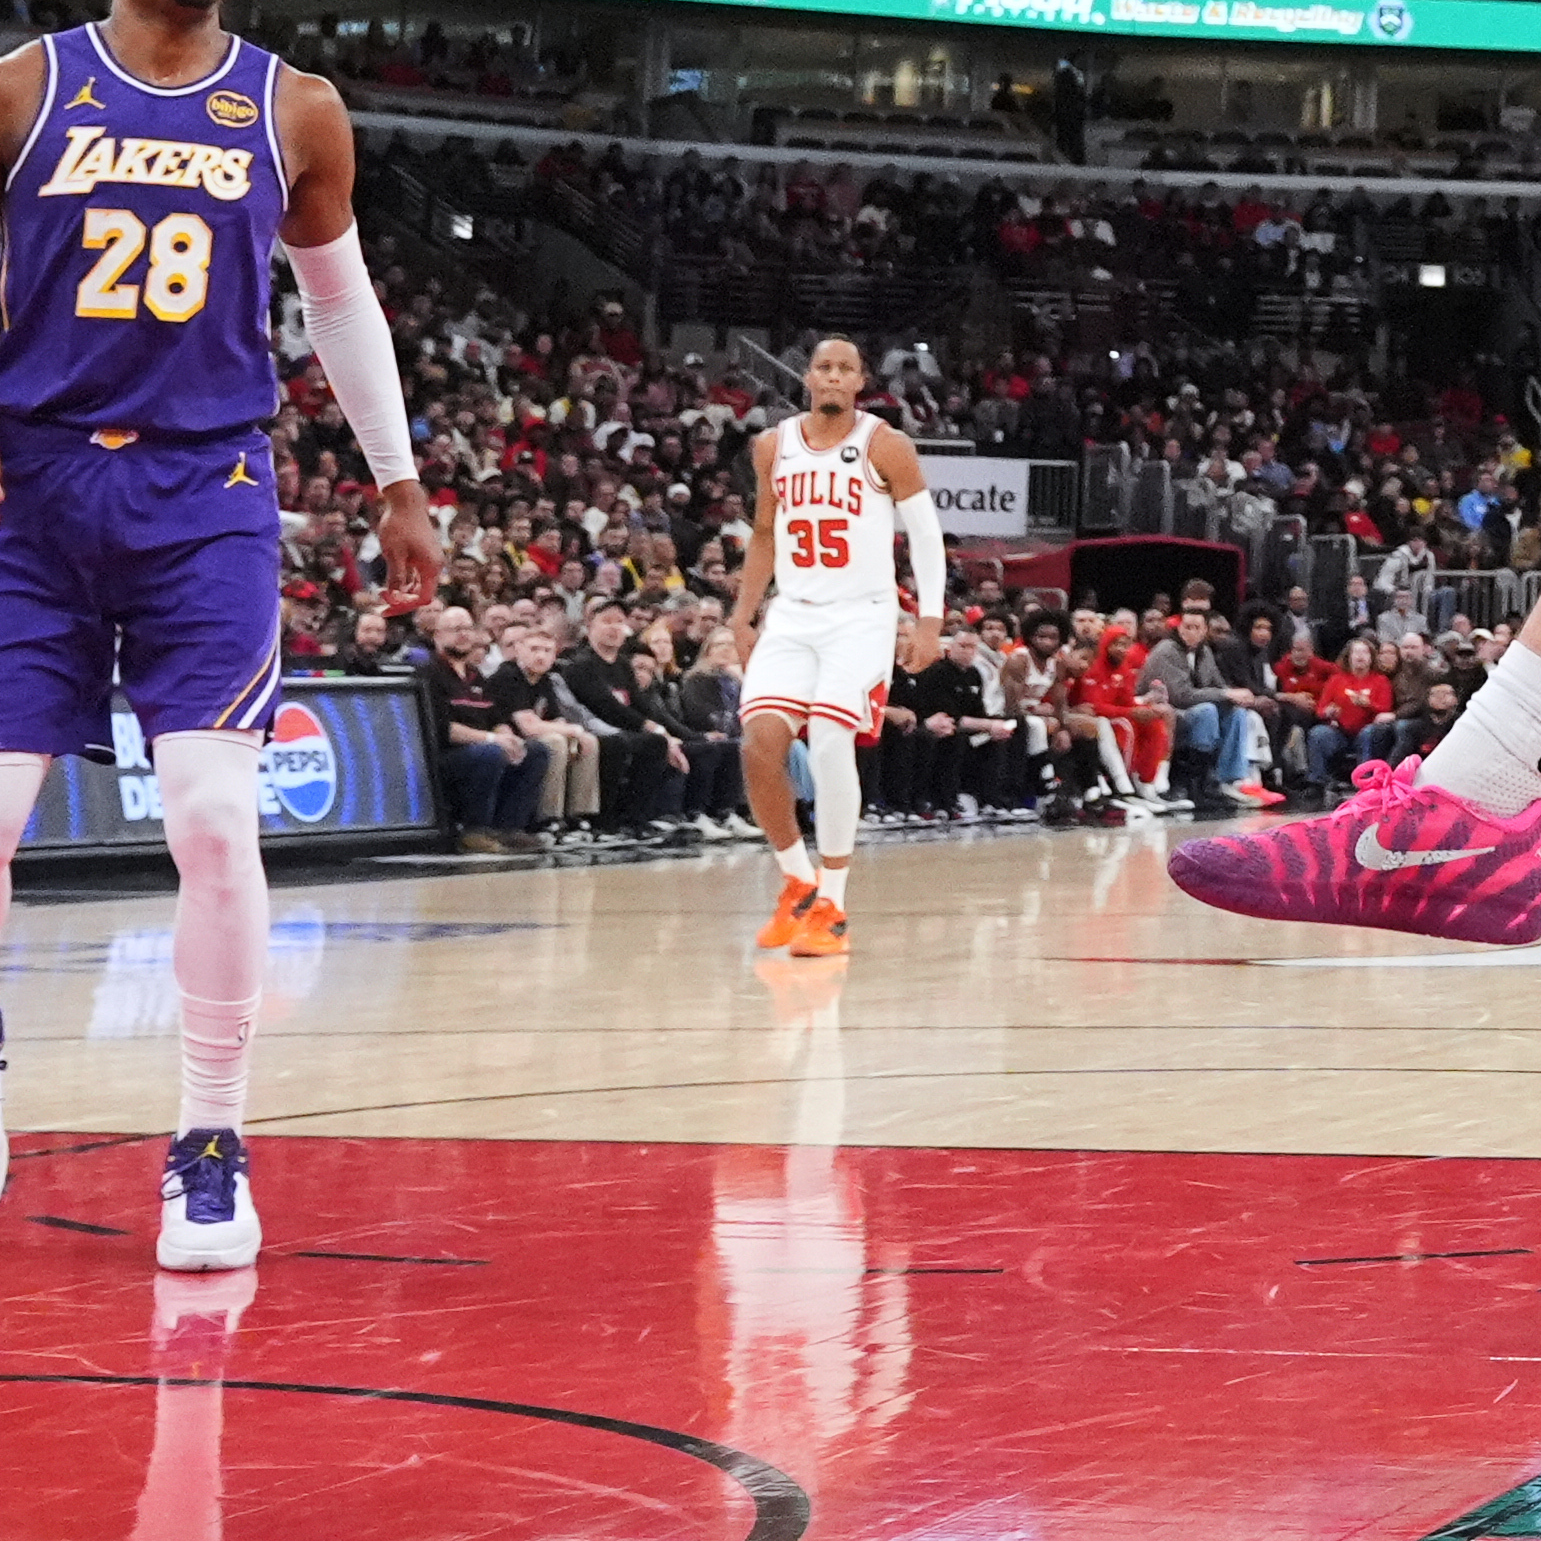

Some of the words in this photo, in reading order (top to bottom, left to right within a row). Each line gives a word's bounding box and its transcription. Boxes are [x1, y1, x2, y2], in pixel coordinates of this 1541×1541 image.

[37, 125, 255, 202] LAKERS
[75, 206, 214, 323] 28
[935, 485, 1017, 514] ocate
[787, 518, 851, 569] 35
[273, 750, 331, 774] PEPSI
